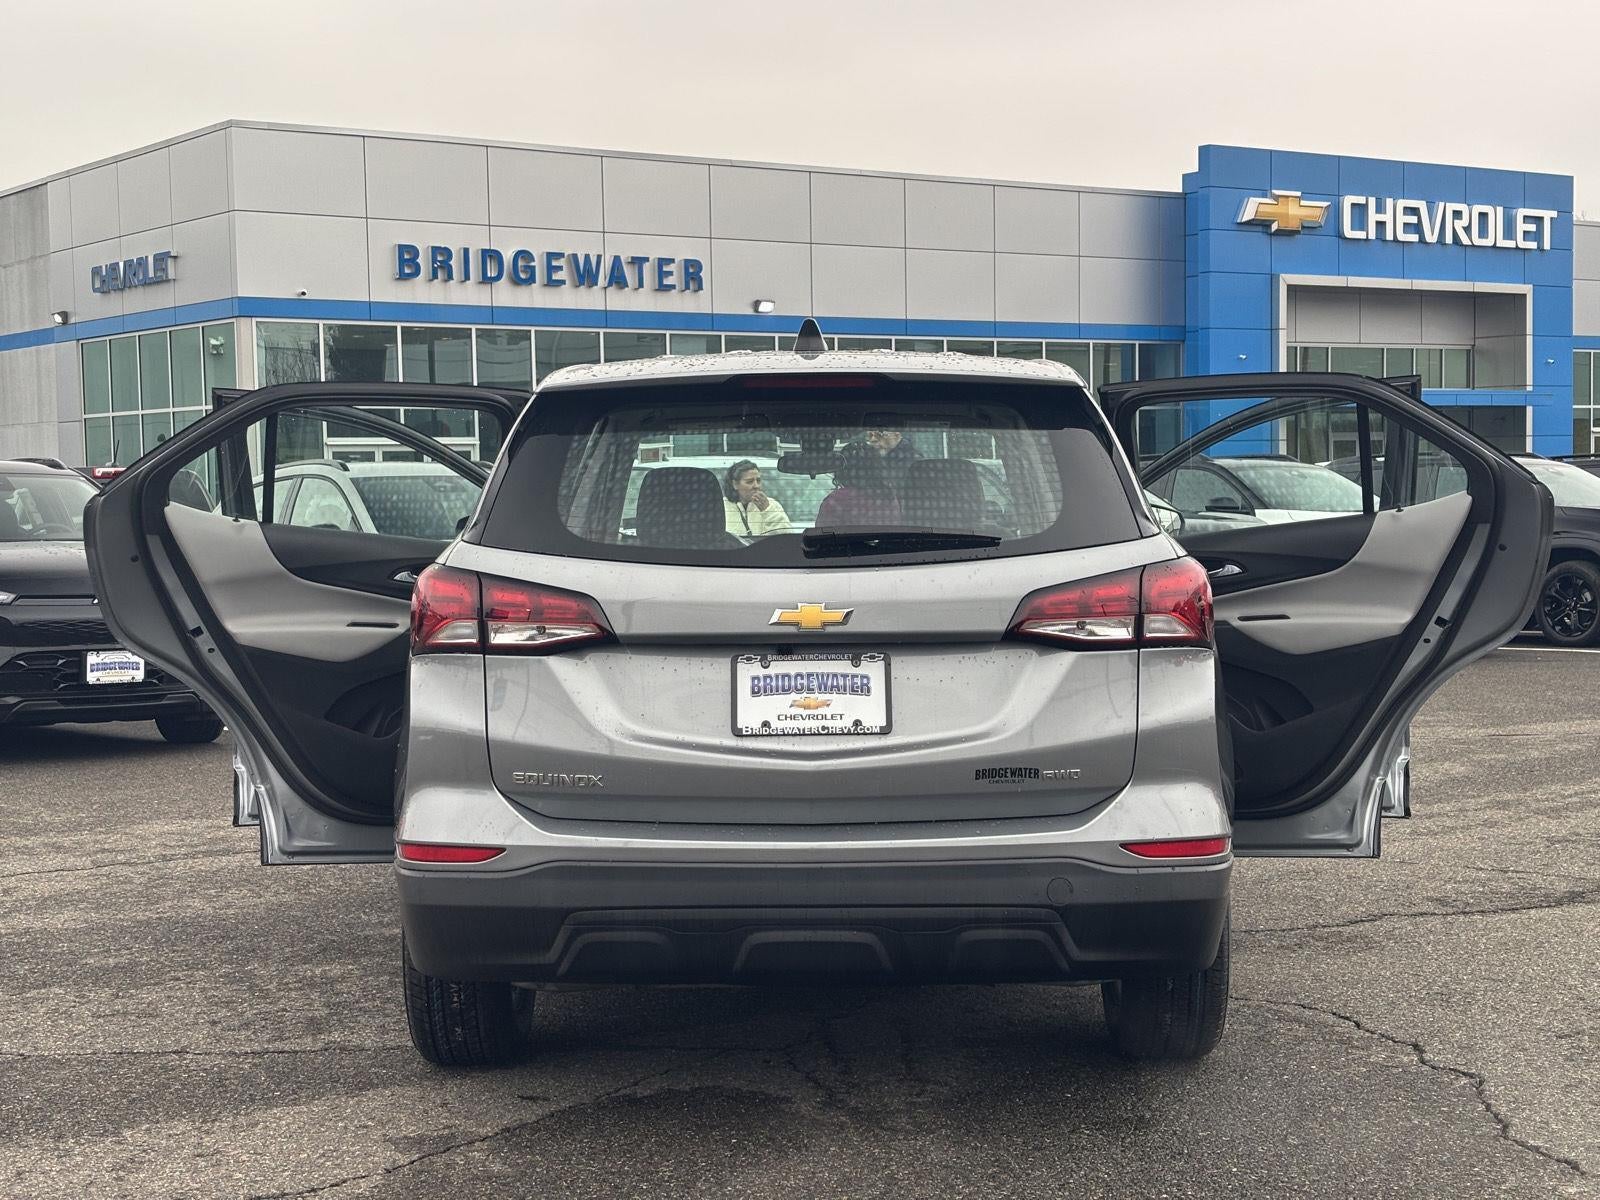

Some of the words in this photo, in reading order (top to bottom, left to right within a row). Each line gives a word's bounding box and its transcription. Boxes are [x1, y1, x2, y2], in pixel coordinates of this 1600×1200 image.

[1340, 194, 1558, 250] CHEVROLET
[91, 249, 178, 293] CHEVROLET
[395, 243, 704, 292] BRIDGEWATER
[750, 671, 872, 697] BRIDGEWATER
[777, 713, 845, 721] CHEVROLET
[512, 771, 604, 787] EQUINOX
[975, 767, 1040, 781] BRIDGEWATER
